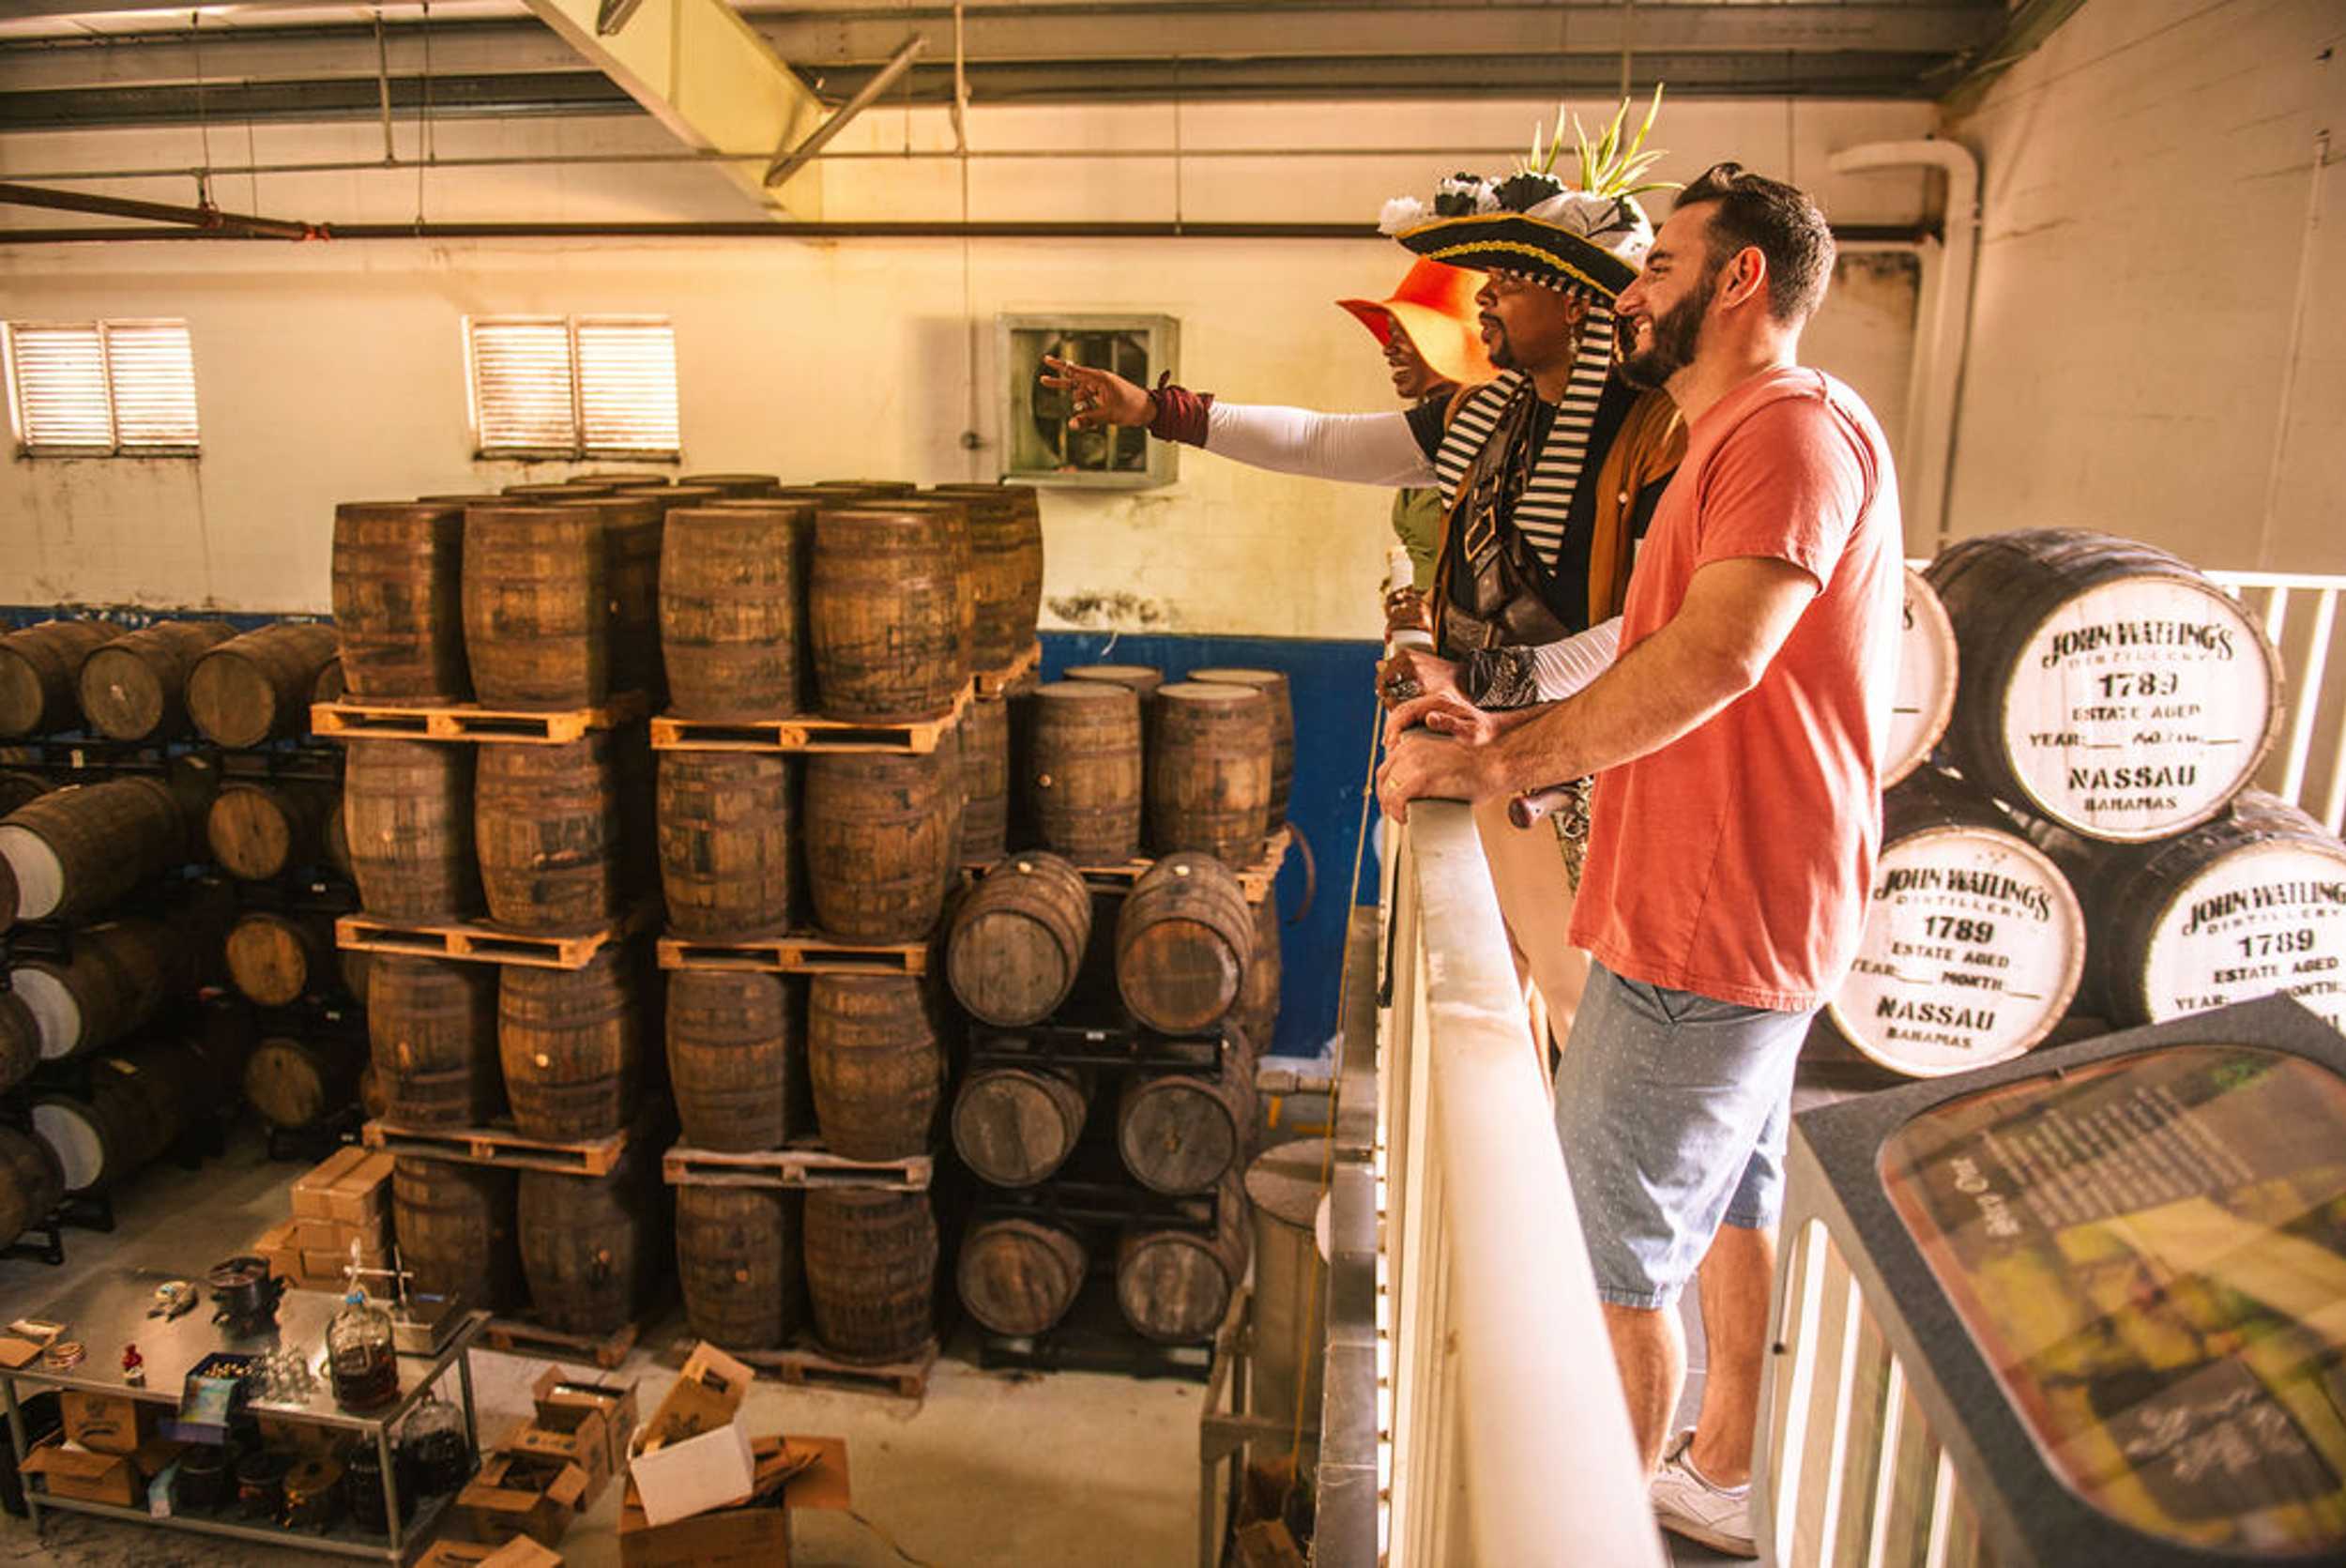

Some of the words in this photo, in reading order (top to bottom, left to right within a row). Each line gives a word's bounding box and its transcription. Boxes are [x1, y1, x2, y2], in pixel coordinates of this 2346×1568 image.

[2041, 623, 2111, 669] JOHN
[2098, 671, 2178, 698] 1789
[2072, 707, 2140, 722] ESTATE
[2151, 704, 2201, 720] AGED
[2068, 764, 2196, 790] NASSAU
[2084, 796, 2177, 812] BAHAMAS
[1872, 868, 1941, 902] JOHN
[2182, 891, 2247, 936] JOHN
[1925, 915, 1995, 945] 1789
[2237, 928, 2315, 957] 1789
[1891, 941, 1954, 962] ESTATE
[1963, 951, 2010, 968] AGED
[2214, 965, 2278, 984] ESTATE
[2293, 955, 2339, 973] AGED
[1876, 996, 1996, 1031] NASSAU
[1886, 1027, 1973, 1049] BAHAMAS
